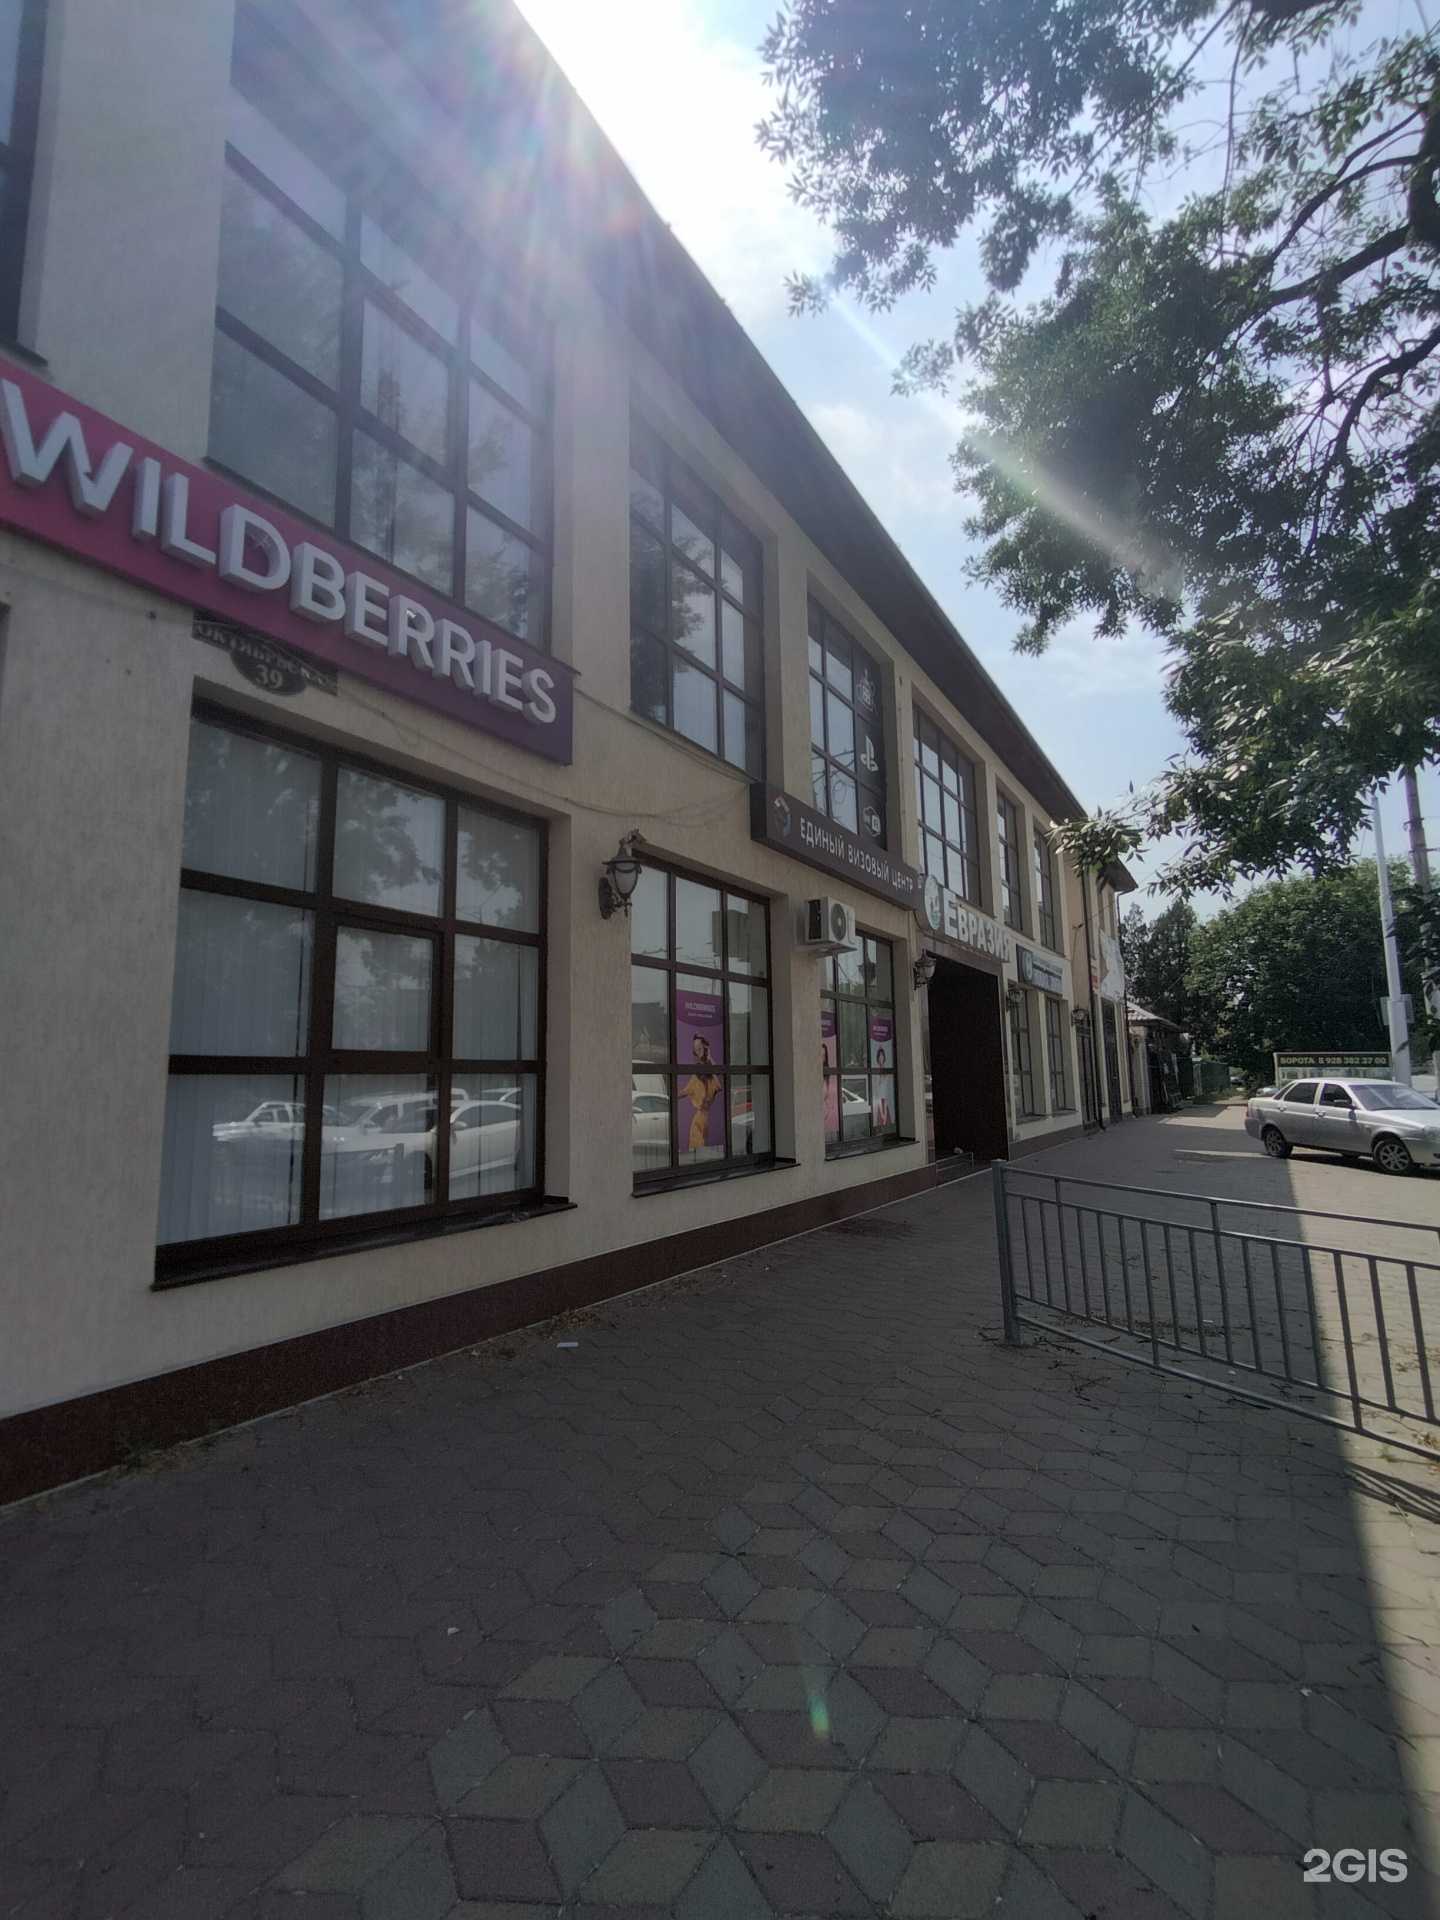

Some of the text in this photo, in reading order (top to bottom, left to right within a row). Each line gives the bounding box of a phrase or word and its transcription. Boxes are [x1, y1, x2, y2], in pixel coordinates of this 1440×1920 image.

[0, 378, 558, 725] WILDBERRIES
[256, 664, 283, 689] 39
[800, 817, 913, 894] ЕДИНЫЙ ВИЗОВЫЙ ЦЕНТР
[943, 887, 1010, 961] ЕВРАЗИЯ
